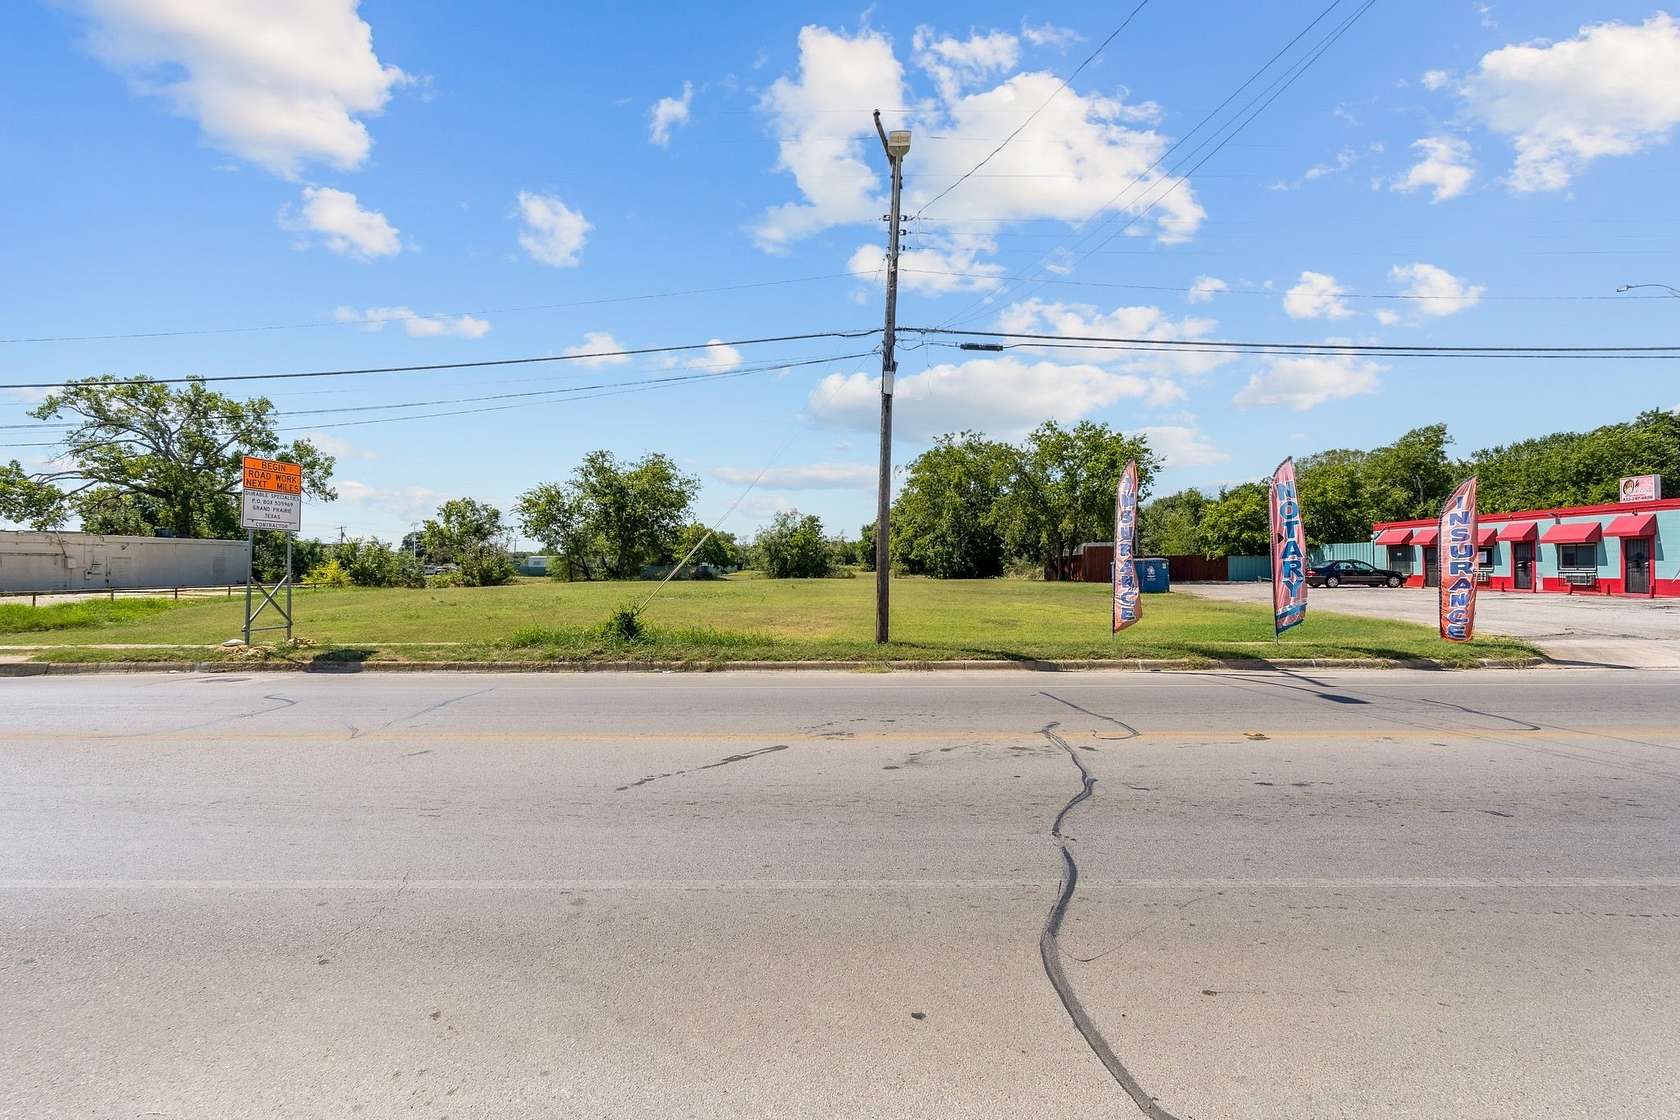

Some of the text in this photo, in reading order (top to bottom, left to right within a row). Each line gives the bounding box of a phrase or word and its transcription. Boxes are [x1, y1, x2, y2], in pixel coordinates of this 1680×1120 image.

[261, 461, 286, 472] BEGIN
[248, 470, 297, 484] ROAD WORK
[246, 478, 299, 493] NEXT MILES
[245, 490, 268, 498] DURABLE
[1275, 480, 1305, 598] NOTARY
[1120, 476, 1137, 621] INSURANCE
[1447, 495, 1474, 640] INSURANCE
